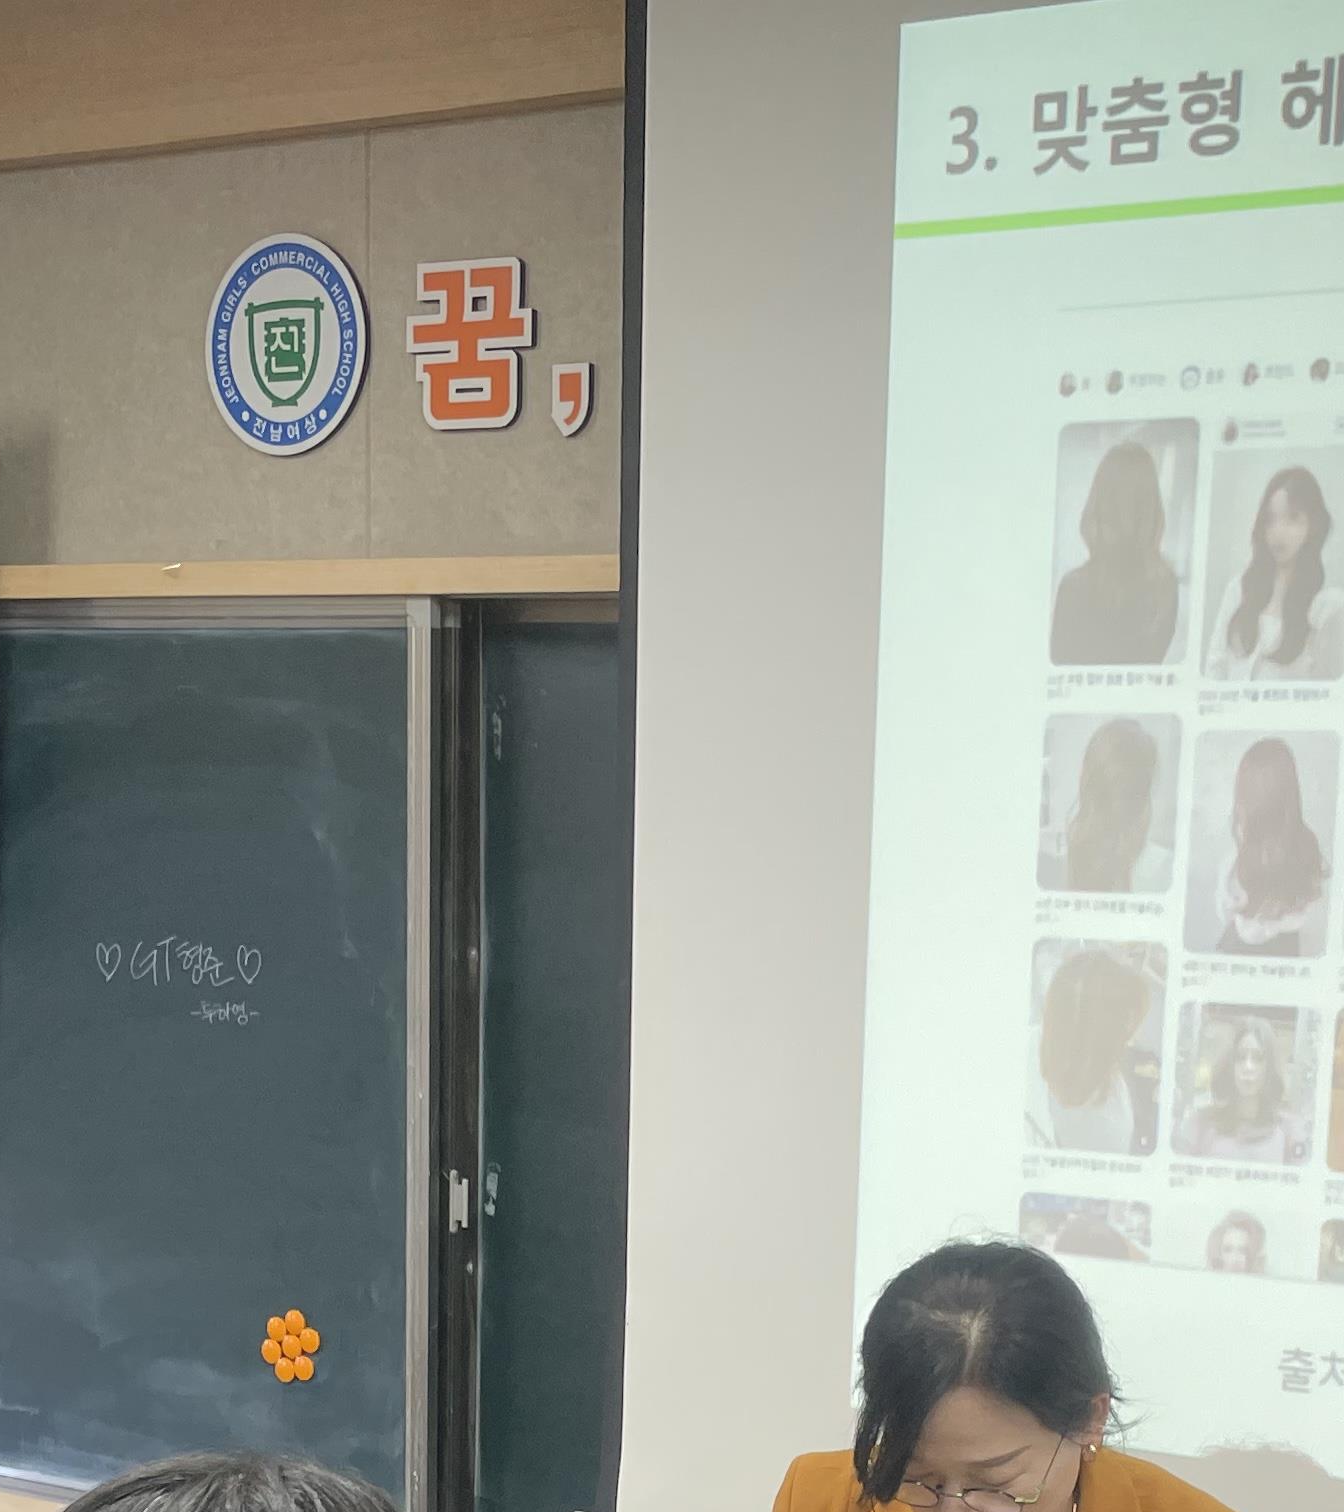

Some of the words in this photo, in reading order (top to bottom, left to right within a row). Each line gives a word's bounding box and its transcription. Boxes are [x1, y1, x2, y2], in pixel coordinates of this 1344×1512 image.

[944, 106, 998, 177] 3.
[1030, 69, 1244, 177] 맞춤형
[250, 250, 331, 284] COMMERCIAL
[330, 282, 352, 324] HIGH
[215, 328, 240, 404] JEONNAM
[330, 327, 354, 397] SCHOOL
[253, 413, 317, 443] 전남여상
